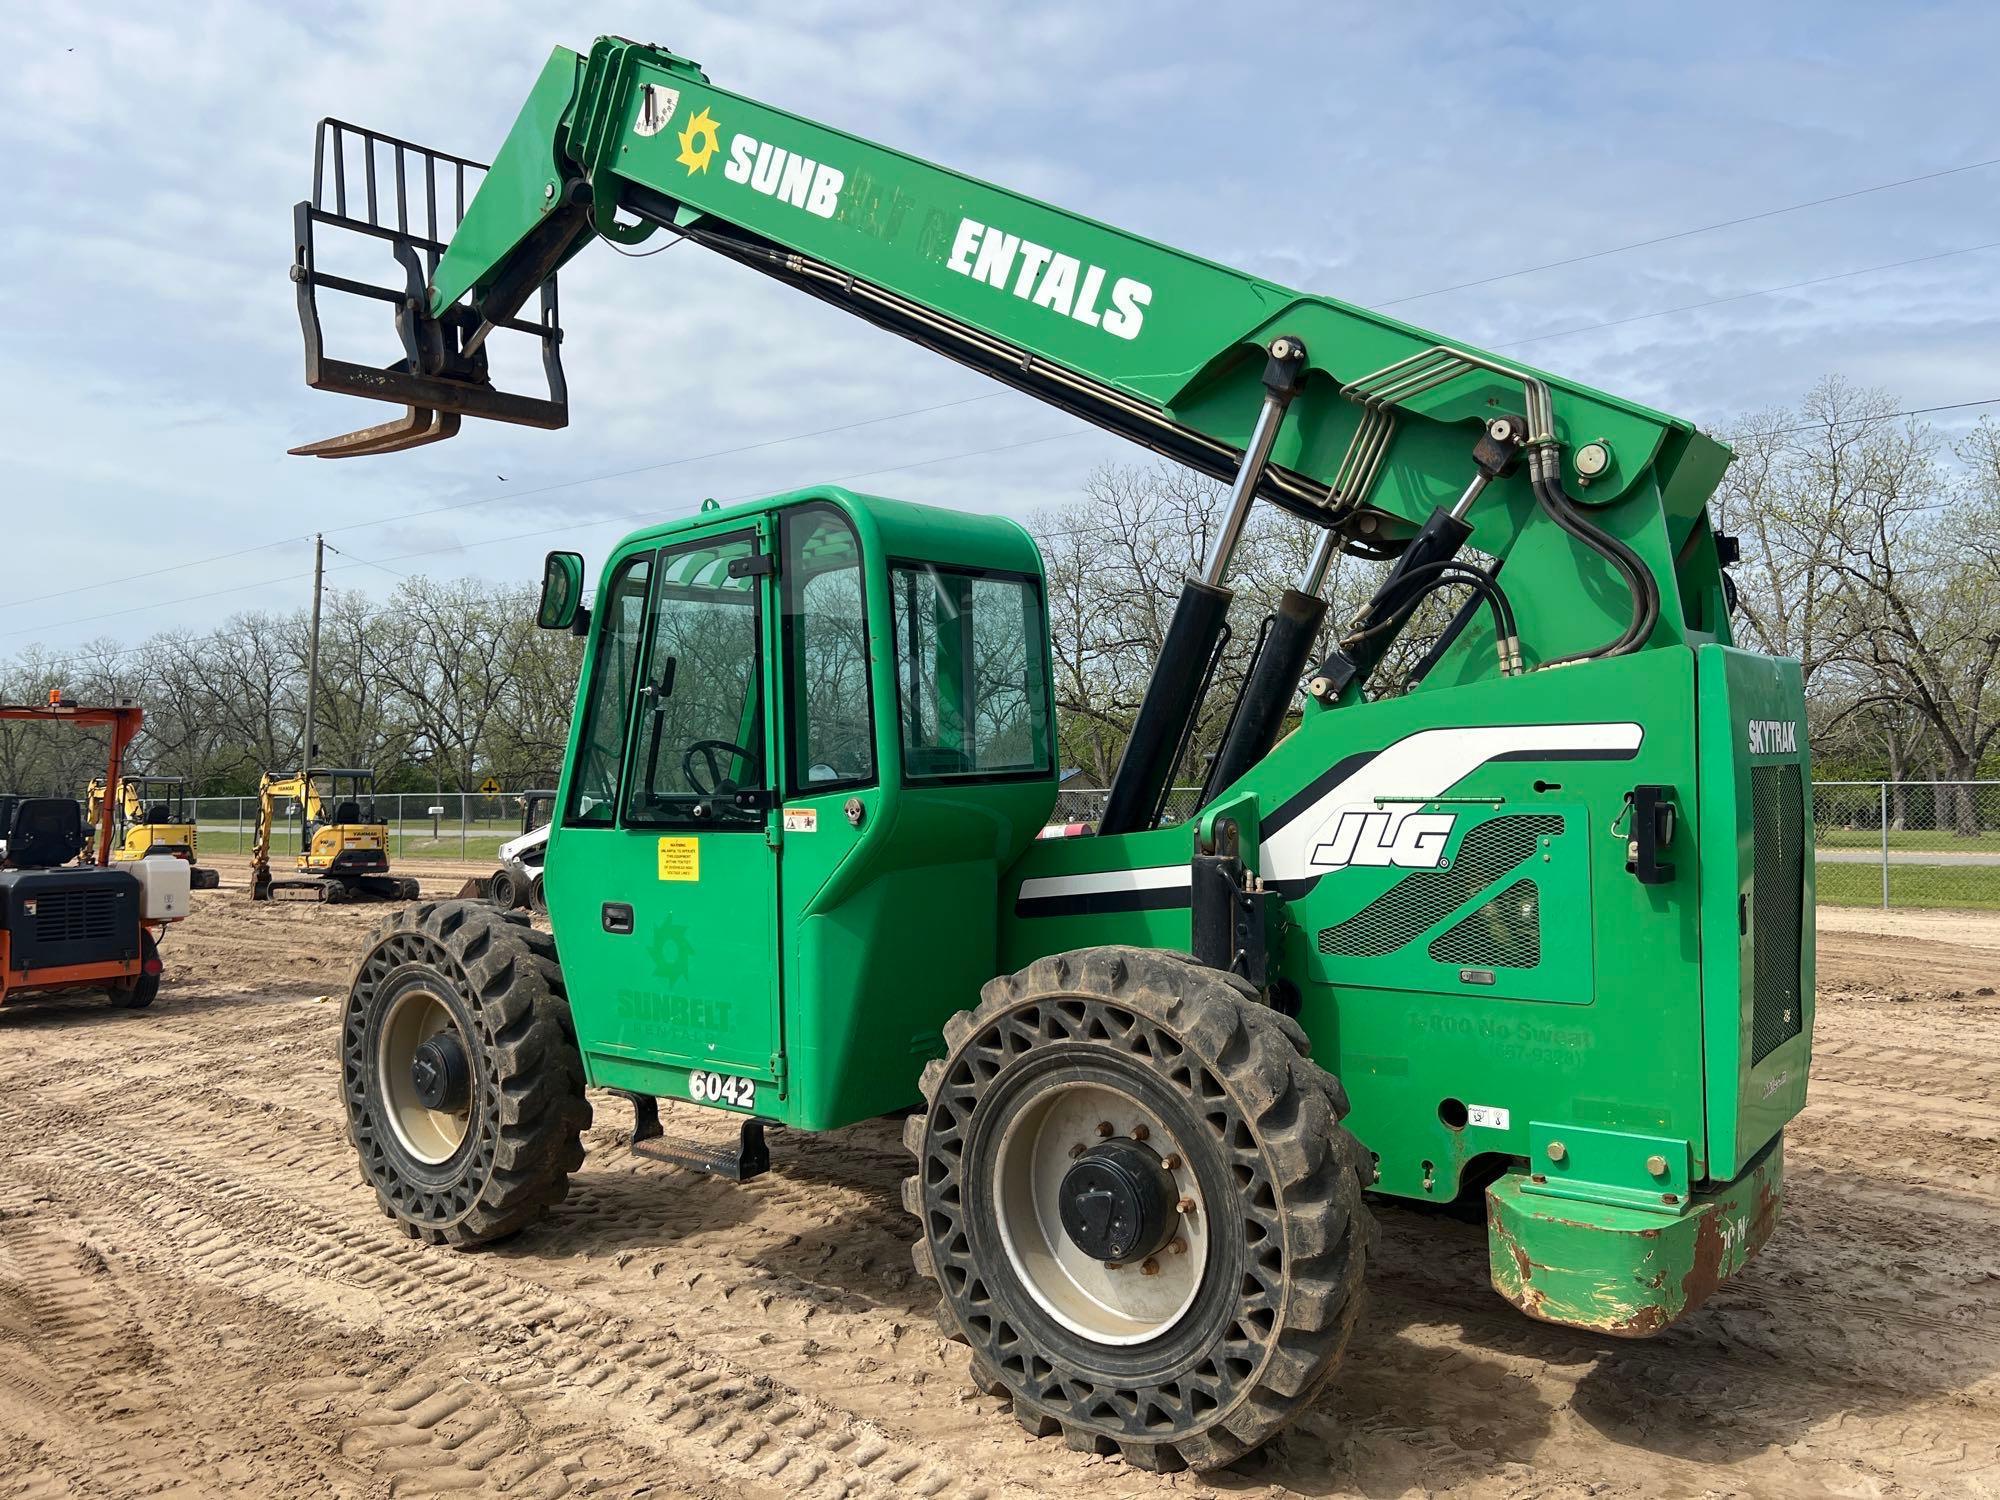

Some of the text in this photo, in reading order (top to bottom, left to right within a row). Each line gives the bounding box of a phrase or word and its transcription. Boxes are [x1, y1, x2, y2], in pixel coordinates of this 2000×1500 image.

[1748, 719, 1797, 754] SKYTRAK
[1310, 812, 1458, 868] JLG
[617, 988, 732, 1033] SUNBELT
[688, 1069, 754, 1108] 6042
